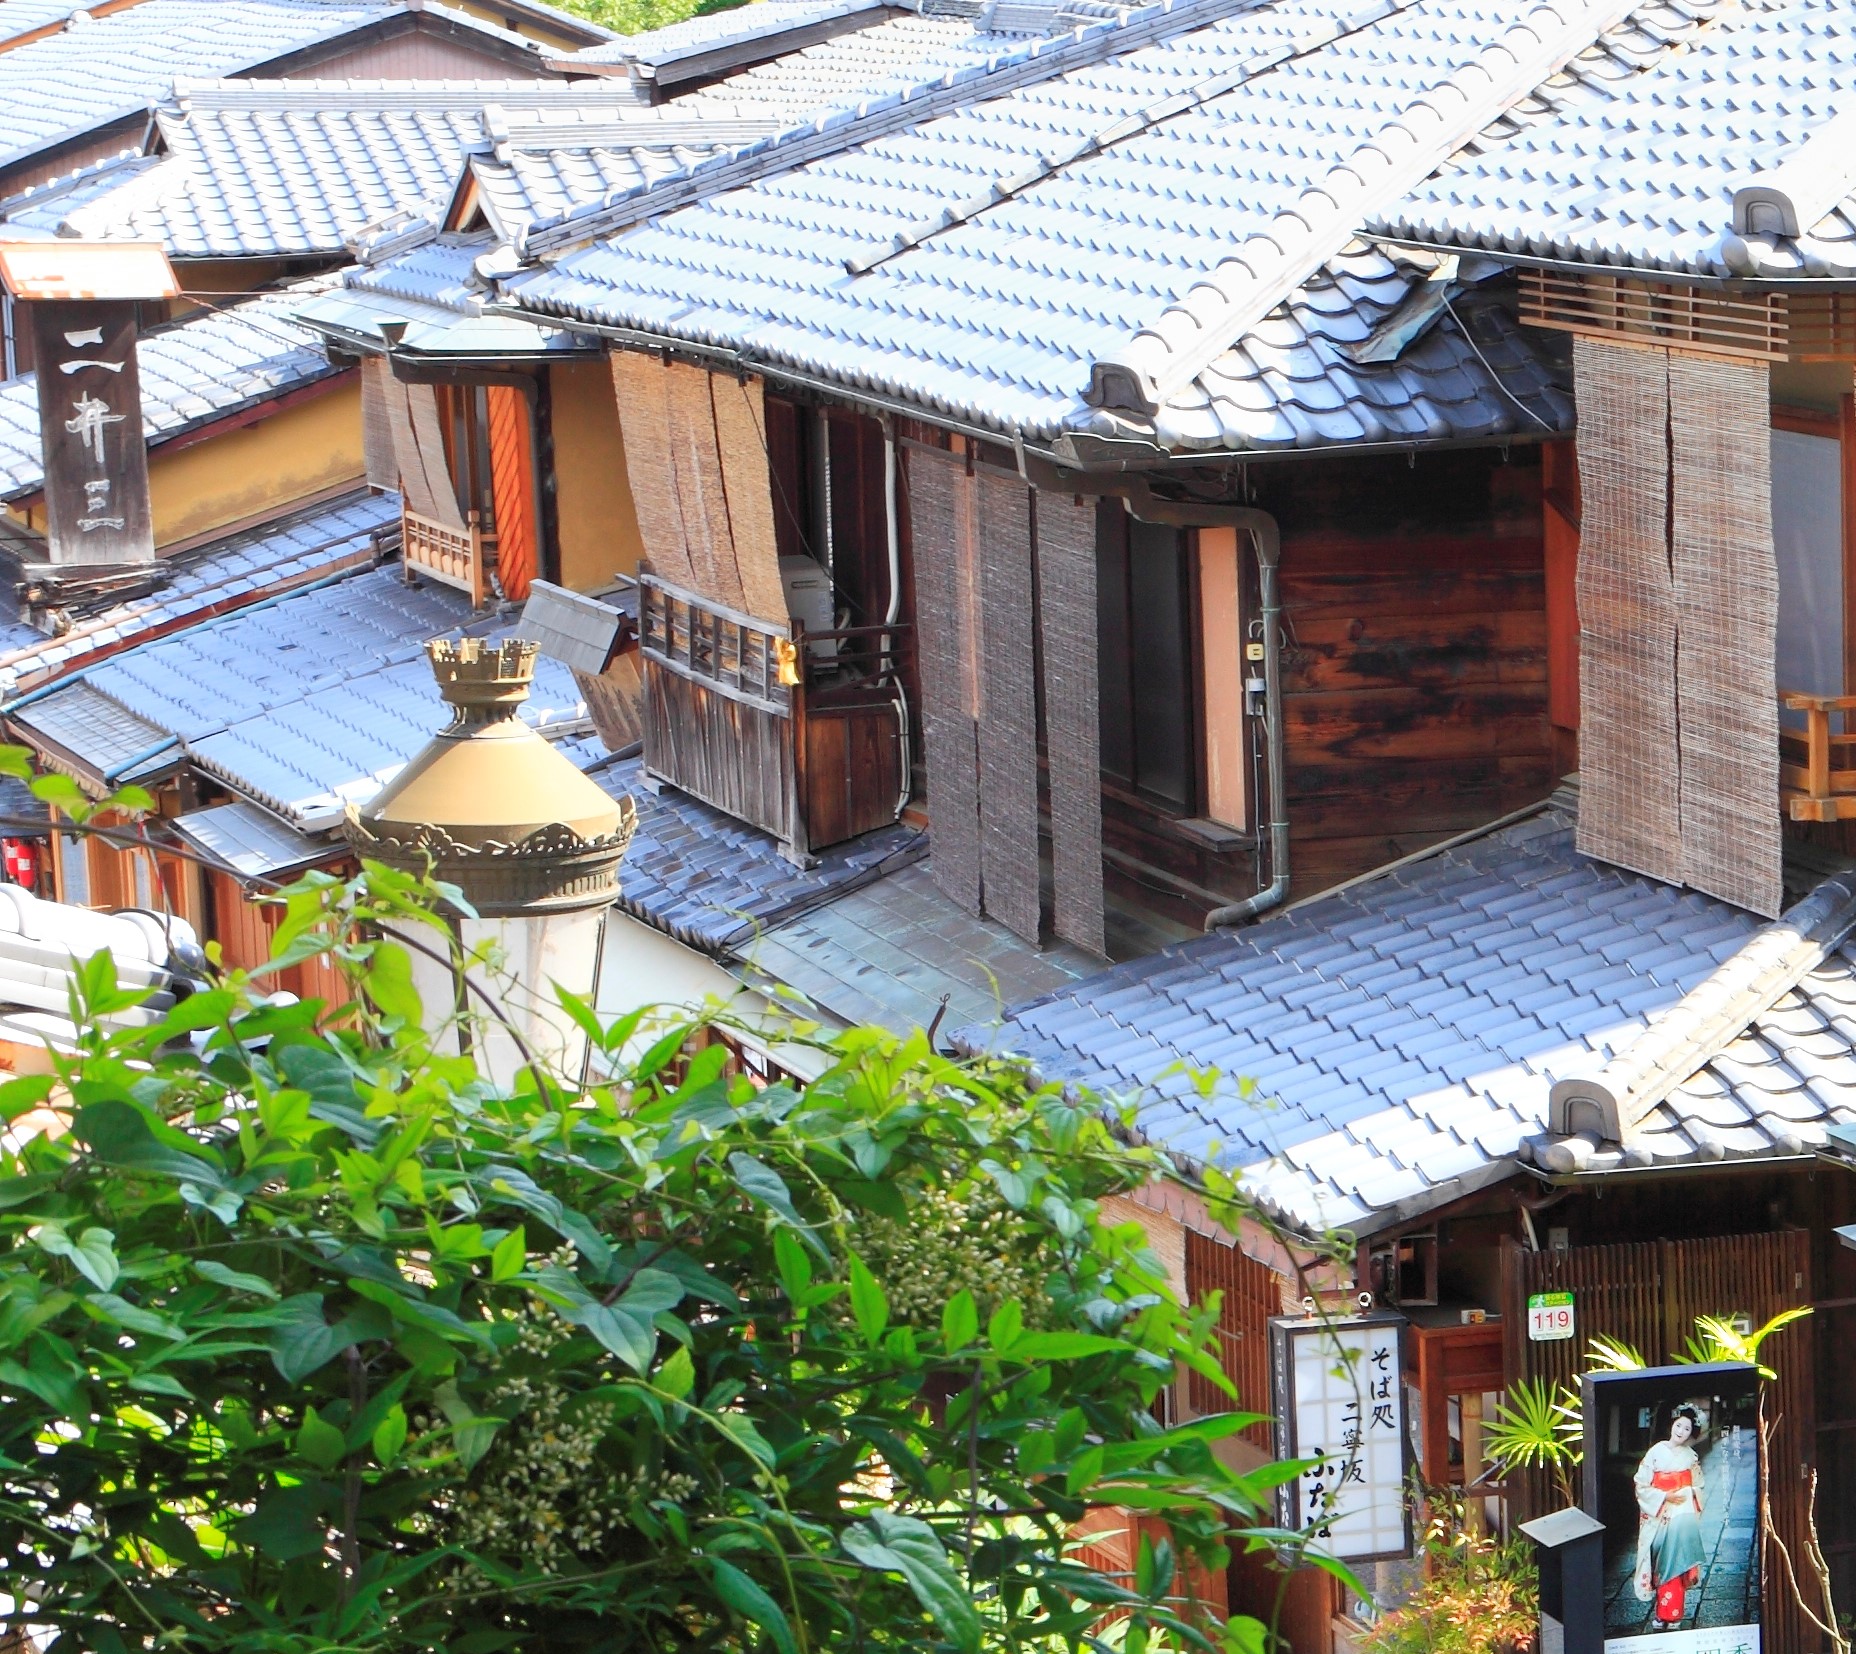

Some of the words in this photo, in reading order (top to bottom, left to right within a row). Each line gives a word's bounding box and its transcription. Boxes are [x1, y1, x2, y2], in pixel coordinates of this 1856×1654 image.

[1535, 1311, 1569, 1329] 119
[1370, 1347, 1396, 1429] そば処
[1341, 1401, 1366, 1483] 二寧坂
